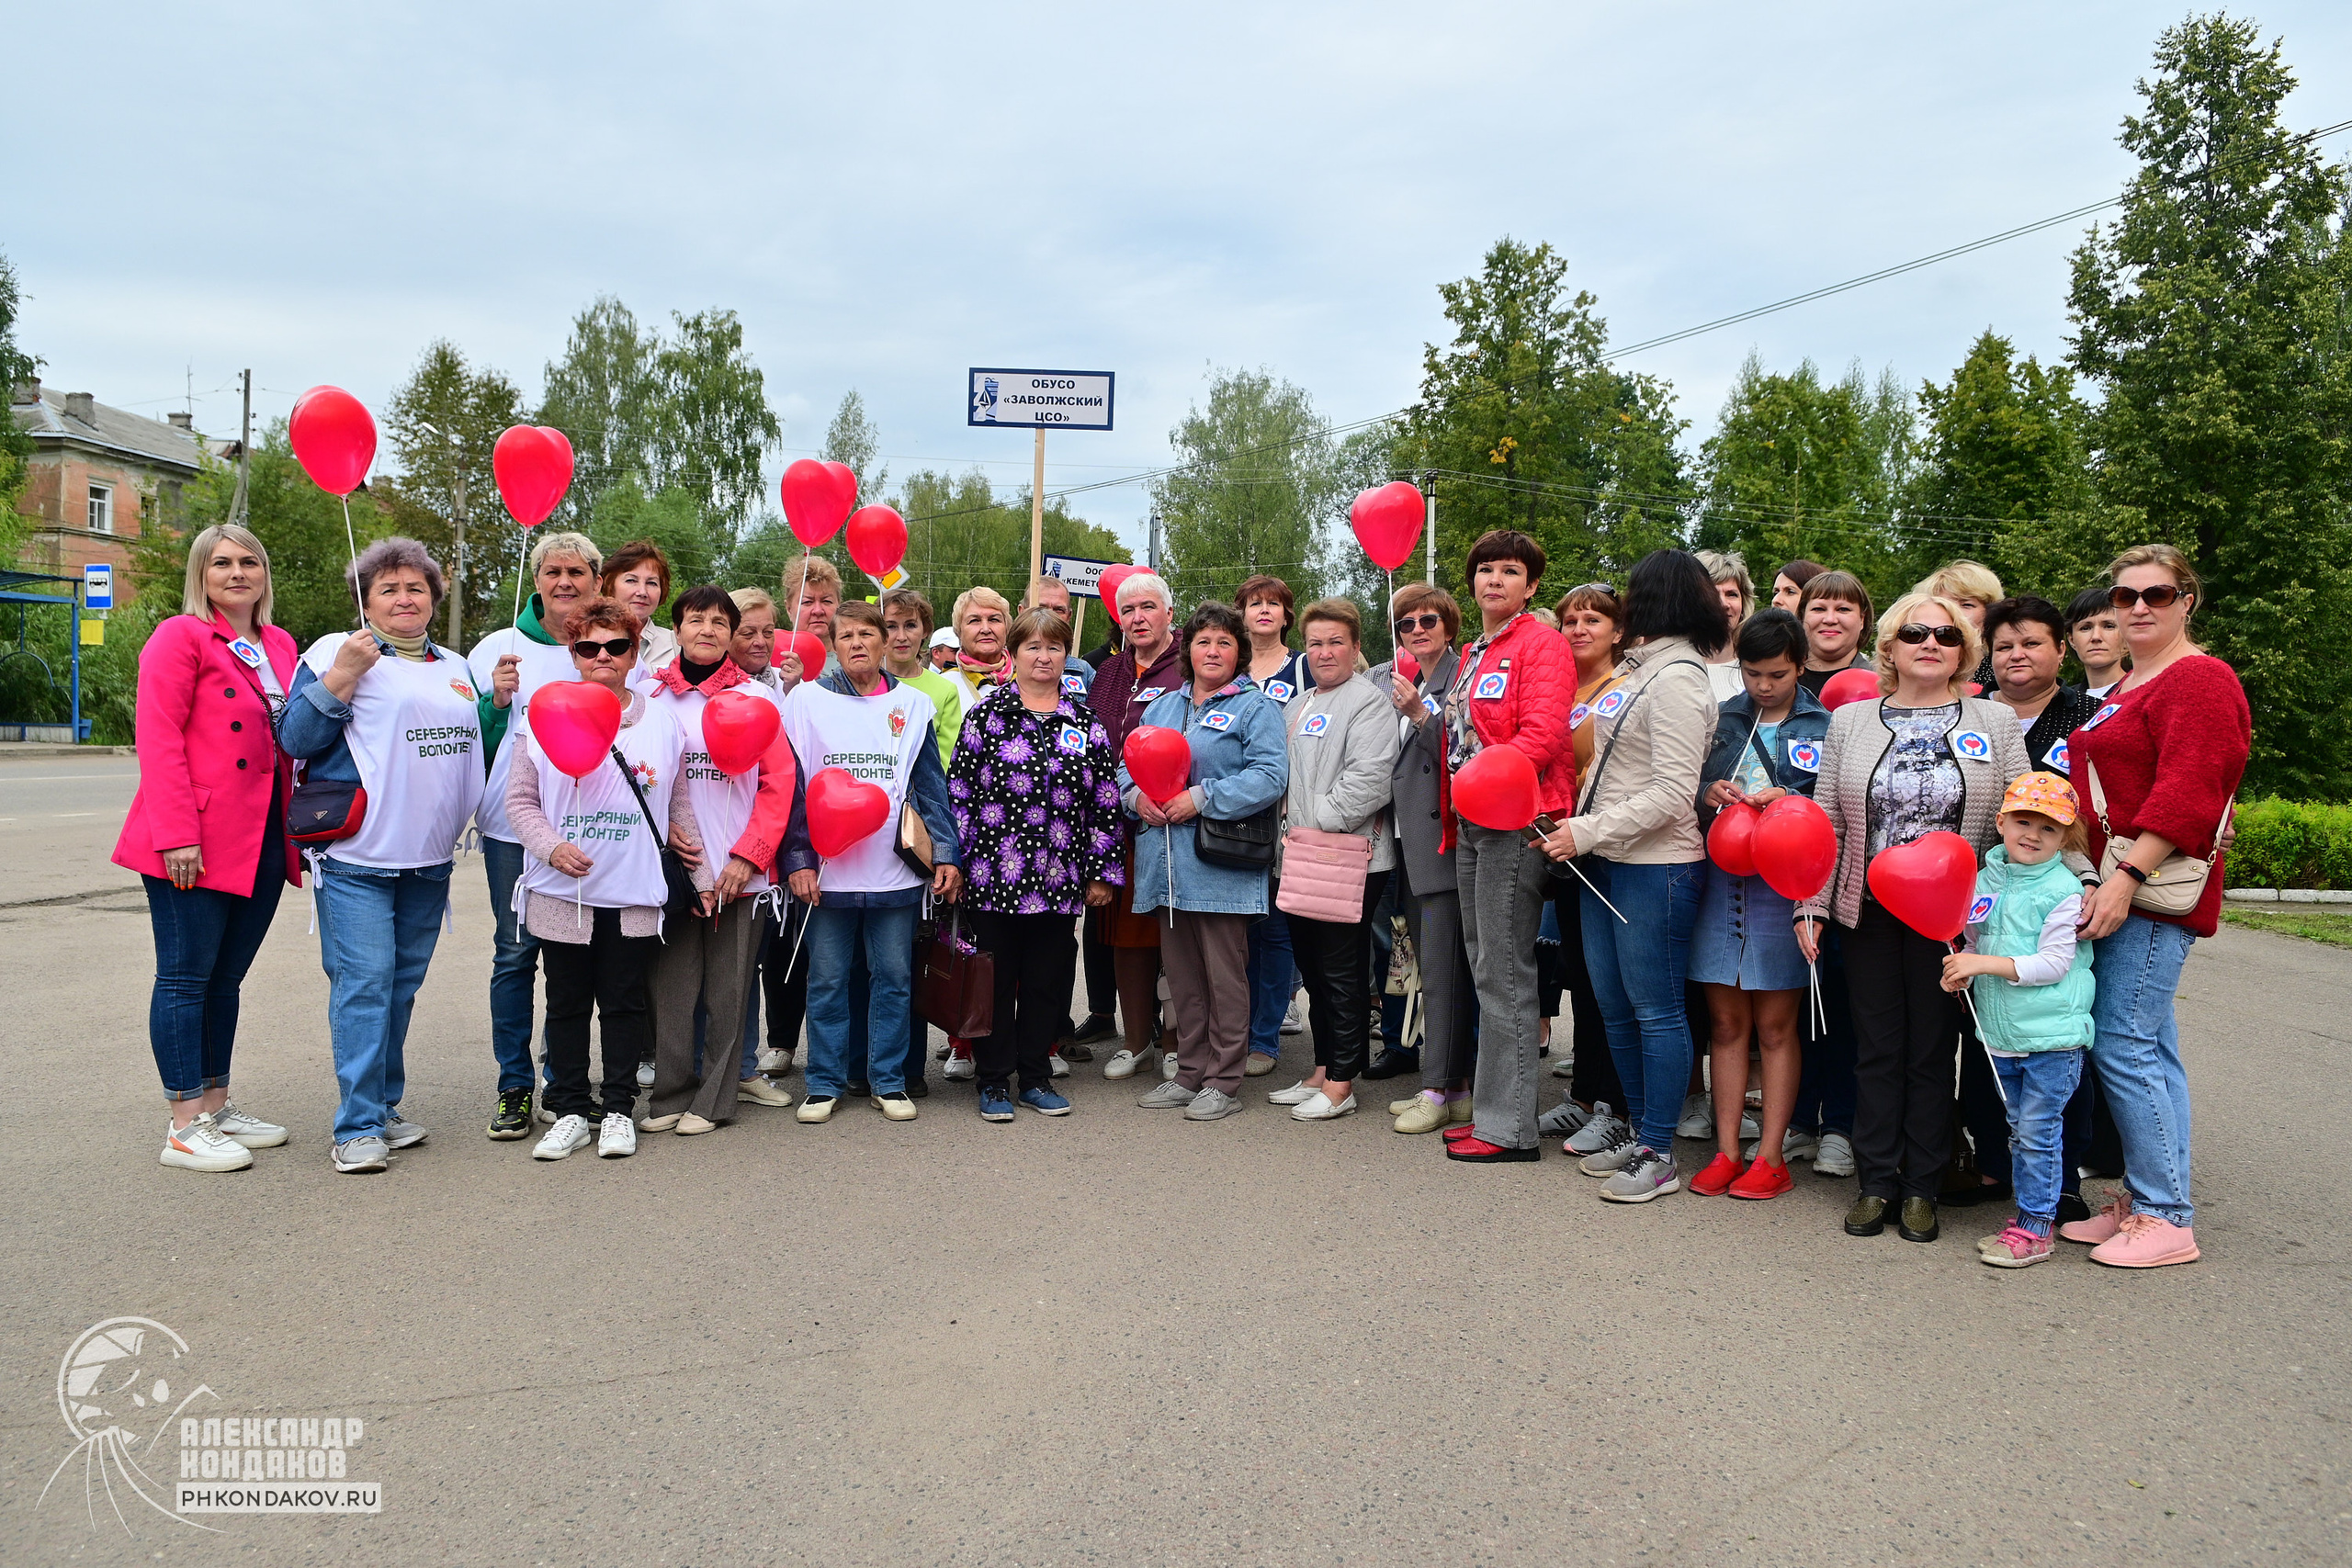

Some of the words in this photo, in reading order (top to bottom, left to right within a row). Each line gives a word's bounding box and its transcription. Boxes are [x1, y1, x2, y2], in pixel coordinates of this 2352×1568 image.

[1031, 378, 1076, 389] ОБУСО
[1003, 394, 1102, 407] «ЗАВОЛЖСКИЙ
[1035, 412, 1070, 423] ЦСО»
[418, 741, 470, 758] ВОЛОНТЕ
